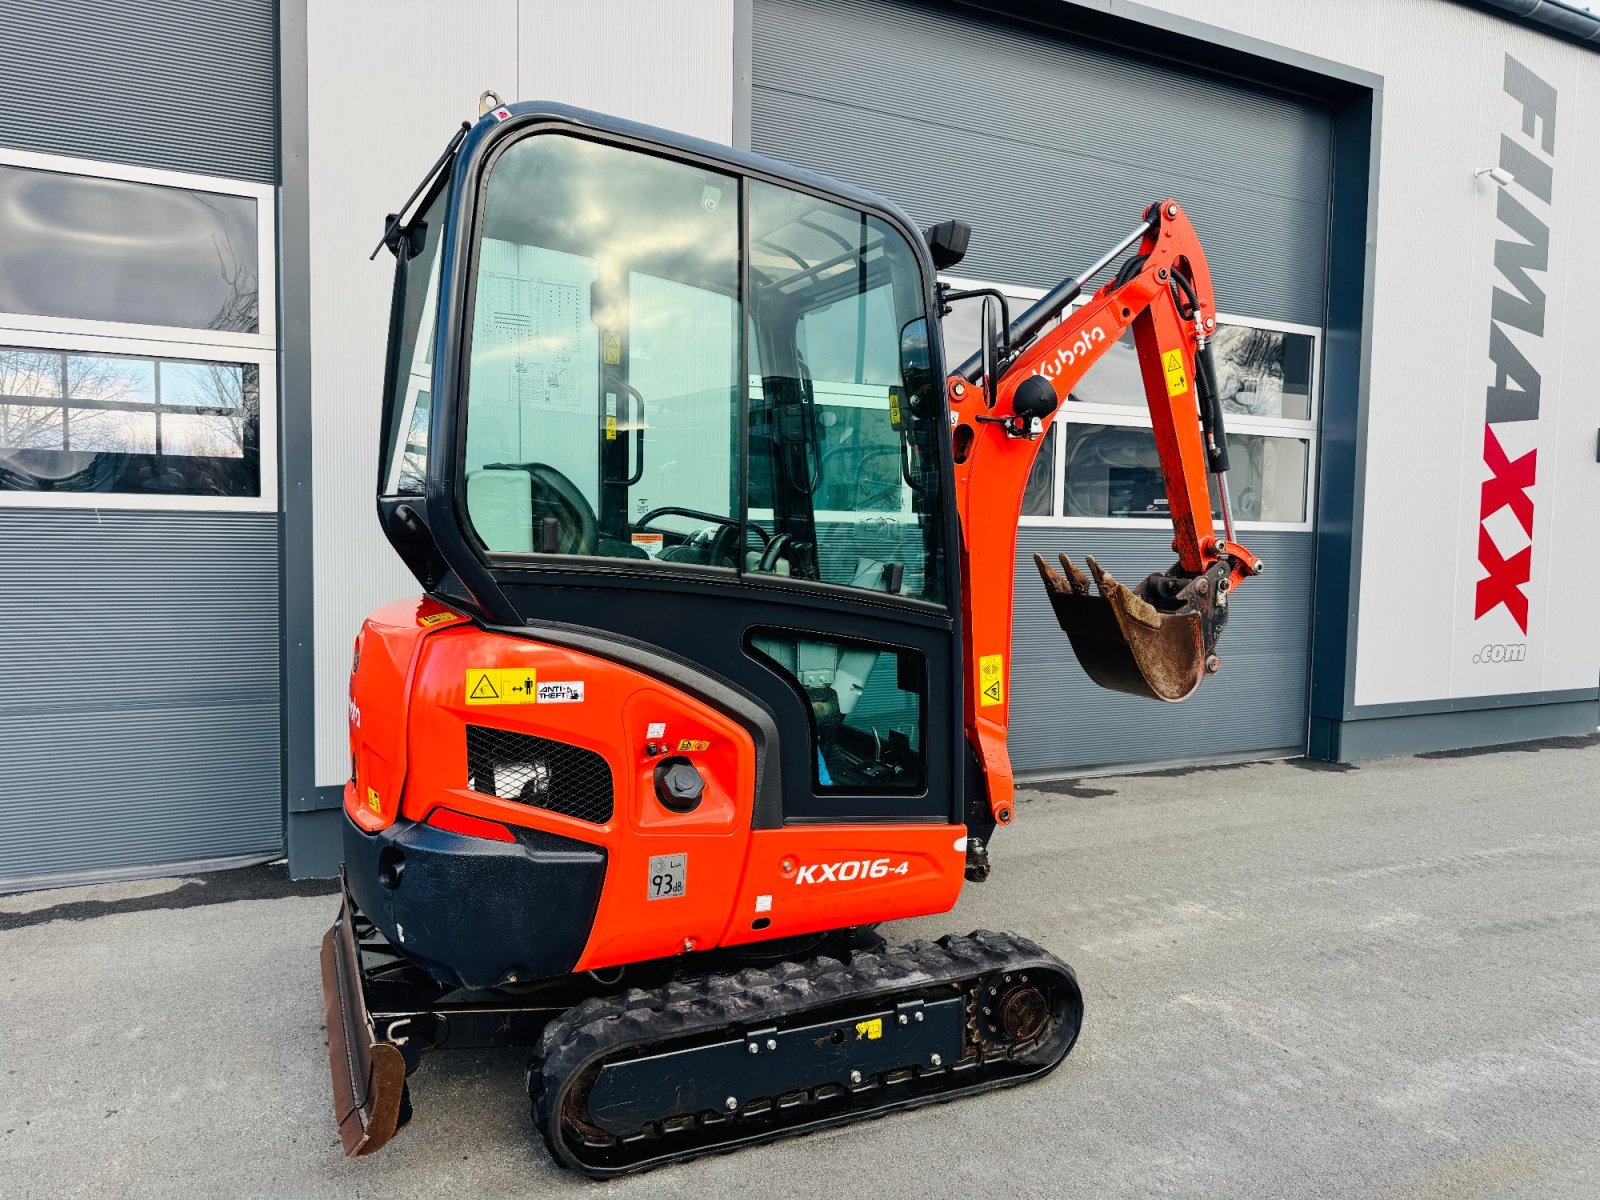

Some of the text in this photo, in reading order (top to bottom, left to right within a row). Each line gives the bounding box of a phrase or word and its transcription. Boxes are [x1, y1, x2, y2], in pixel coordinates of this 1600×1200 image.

[1475, 52, 1557, 637] FIMAXX
[1472, 643, 1527, 664] .com
[795, 858, 909, 885] KX016-4
[652, 873, 673, 895] 93
